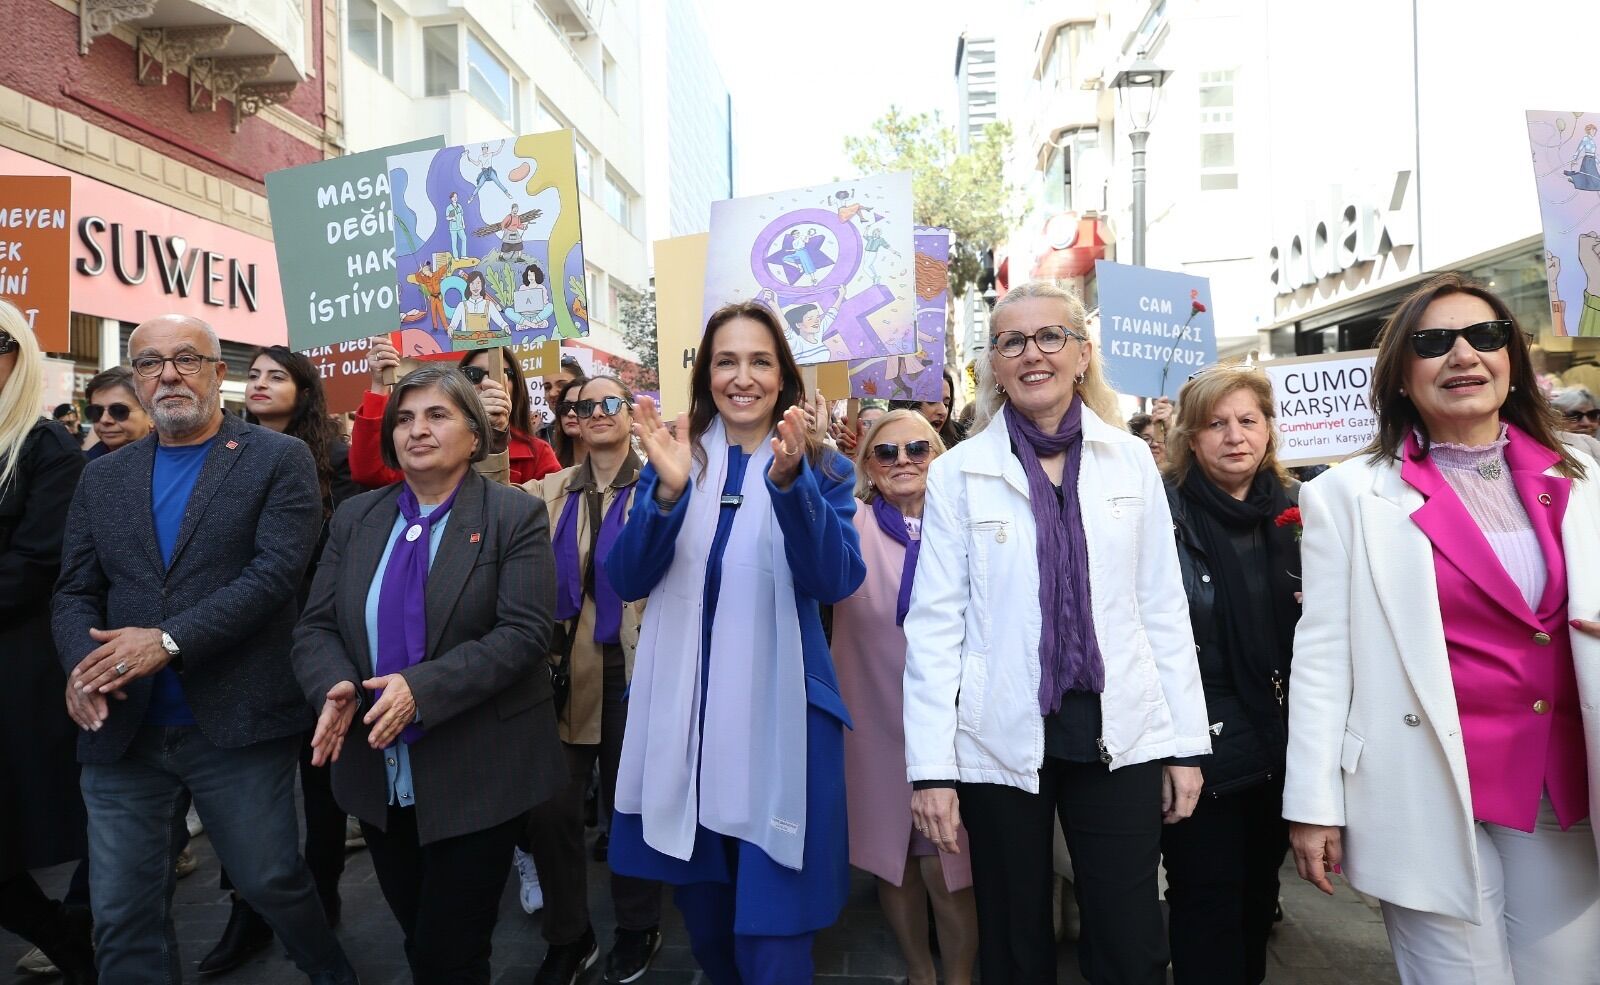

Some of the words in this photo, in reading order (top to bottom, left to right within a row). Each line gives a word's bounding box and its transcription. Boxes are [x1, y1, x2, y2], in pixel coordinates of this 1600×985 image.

[77, 216, 259, 312] SUWEN
[347, 248, 397, 278] HAK
[309, 282, 400, 325] İSTİYO
[1139, 296, 1172, 315] CAM
[1111, 315, 1203, 343] TAVANLARI
[519, 356, 542, 371] SIN
[1111, 339, 1205, 366] KIRIYORUZ
[315, 358, 336, 378] İT
[342, 358, 371, 376] OLU
[1280, 393, 1368, 418] KARŞIYA
[1280, 418, 1345, 433] Cumhuriyet
[1288, 436, 1330, 448] Okurları
